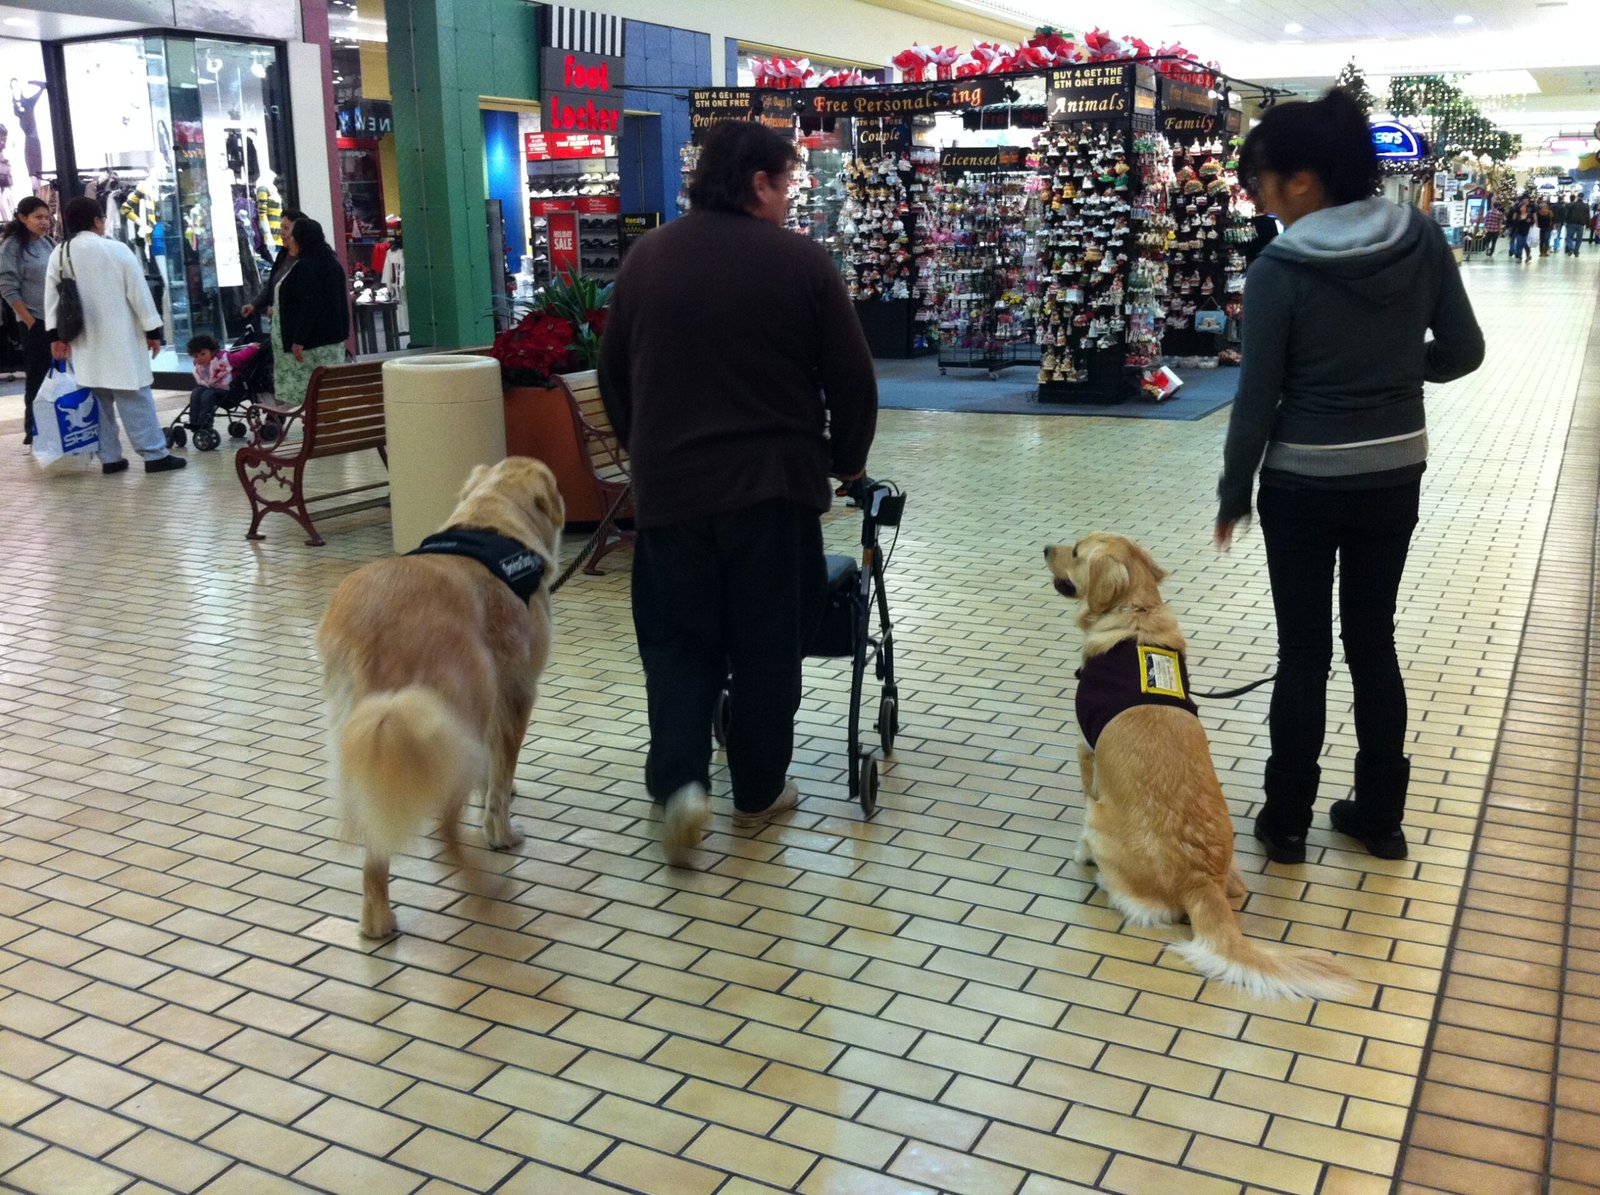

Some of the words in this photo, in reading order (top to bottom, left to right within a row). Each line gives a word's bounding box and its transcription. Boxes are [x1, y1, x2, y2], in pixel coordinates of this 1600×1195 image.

[565, 54, 609, 91] Foot
[1053, 70, 1072, 80] BUY
[1074, 70, 1082, 78] 4
[1084, 68, 1102, 78] GET
[1105, 66, 1124, 76] THE
[1054, 80, 1072, 88] 5TH
[1074, 78, 1094, 87] ONE
[1097, 76, 1122, 86] FREE
[694, 92, 710, 100] BUY
[813, 95, 849, 112] Free
[853, 87, 983, 113] Personaling
[712, 100, 728, 108] ONE
[729, 99, 750, 107] FREE
[1051, 92, 1126, 116] Animals
[552, 95, 620, 133] Locker
[1164, 114, 1214, 133] Family
[860, 129, 900, 144] Couple
[942, 153, 998, 166] Licensed
[554, 238, 573, 250] SALE
